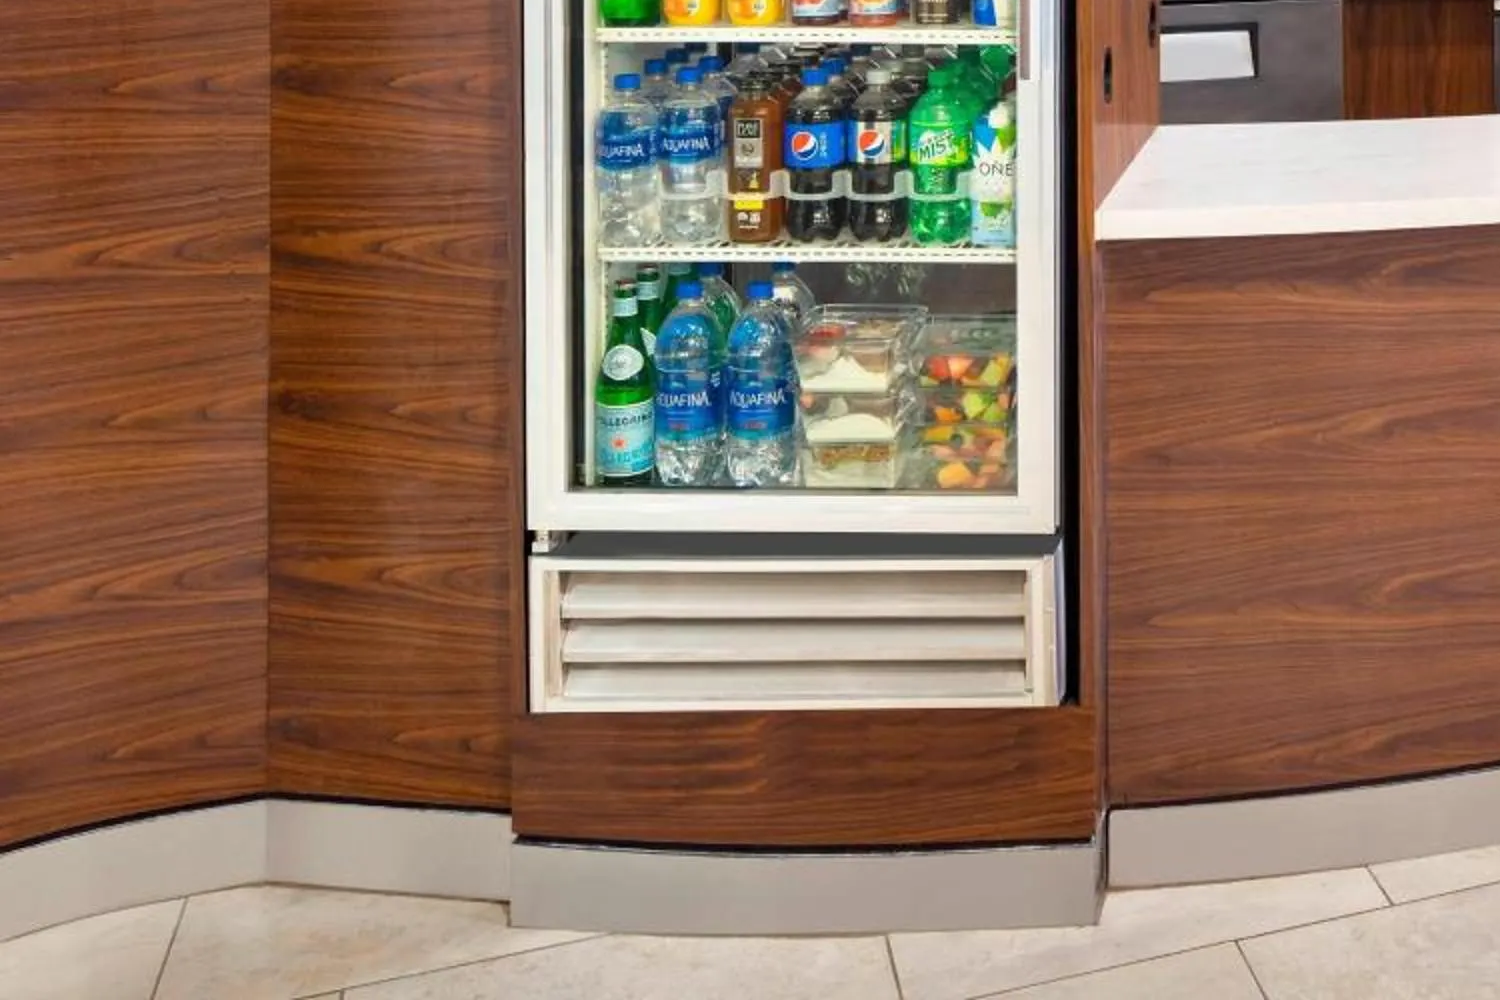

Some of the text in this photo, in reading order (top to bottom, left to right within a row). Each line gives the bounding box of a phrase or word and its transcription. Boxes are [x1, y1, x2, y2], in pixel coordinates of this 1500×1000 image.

[662, 136, 711, 152] AQUAFINA
[979, 160, 1014, 177] ONE
[729, 388, 786, 408] AQUAFINA
